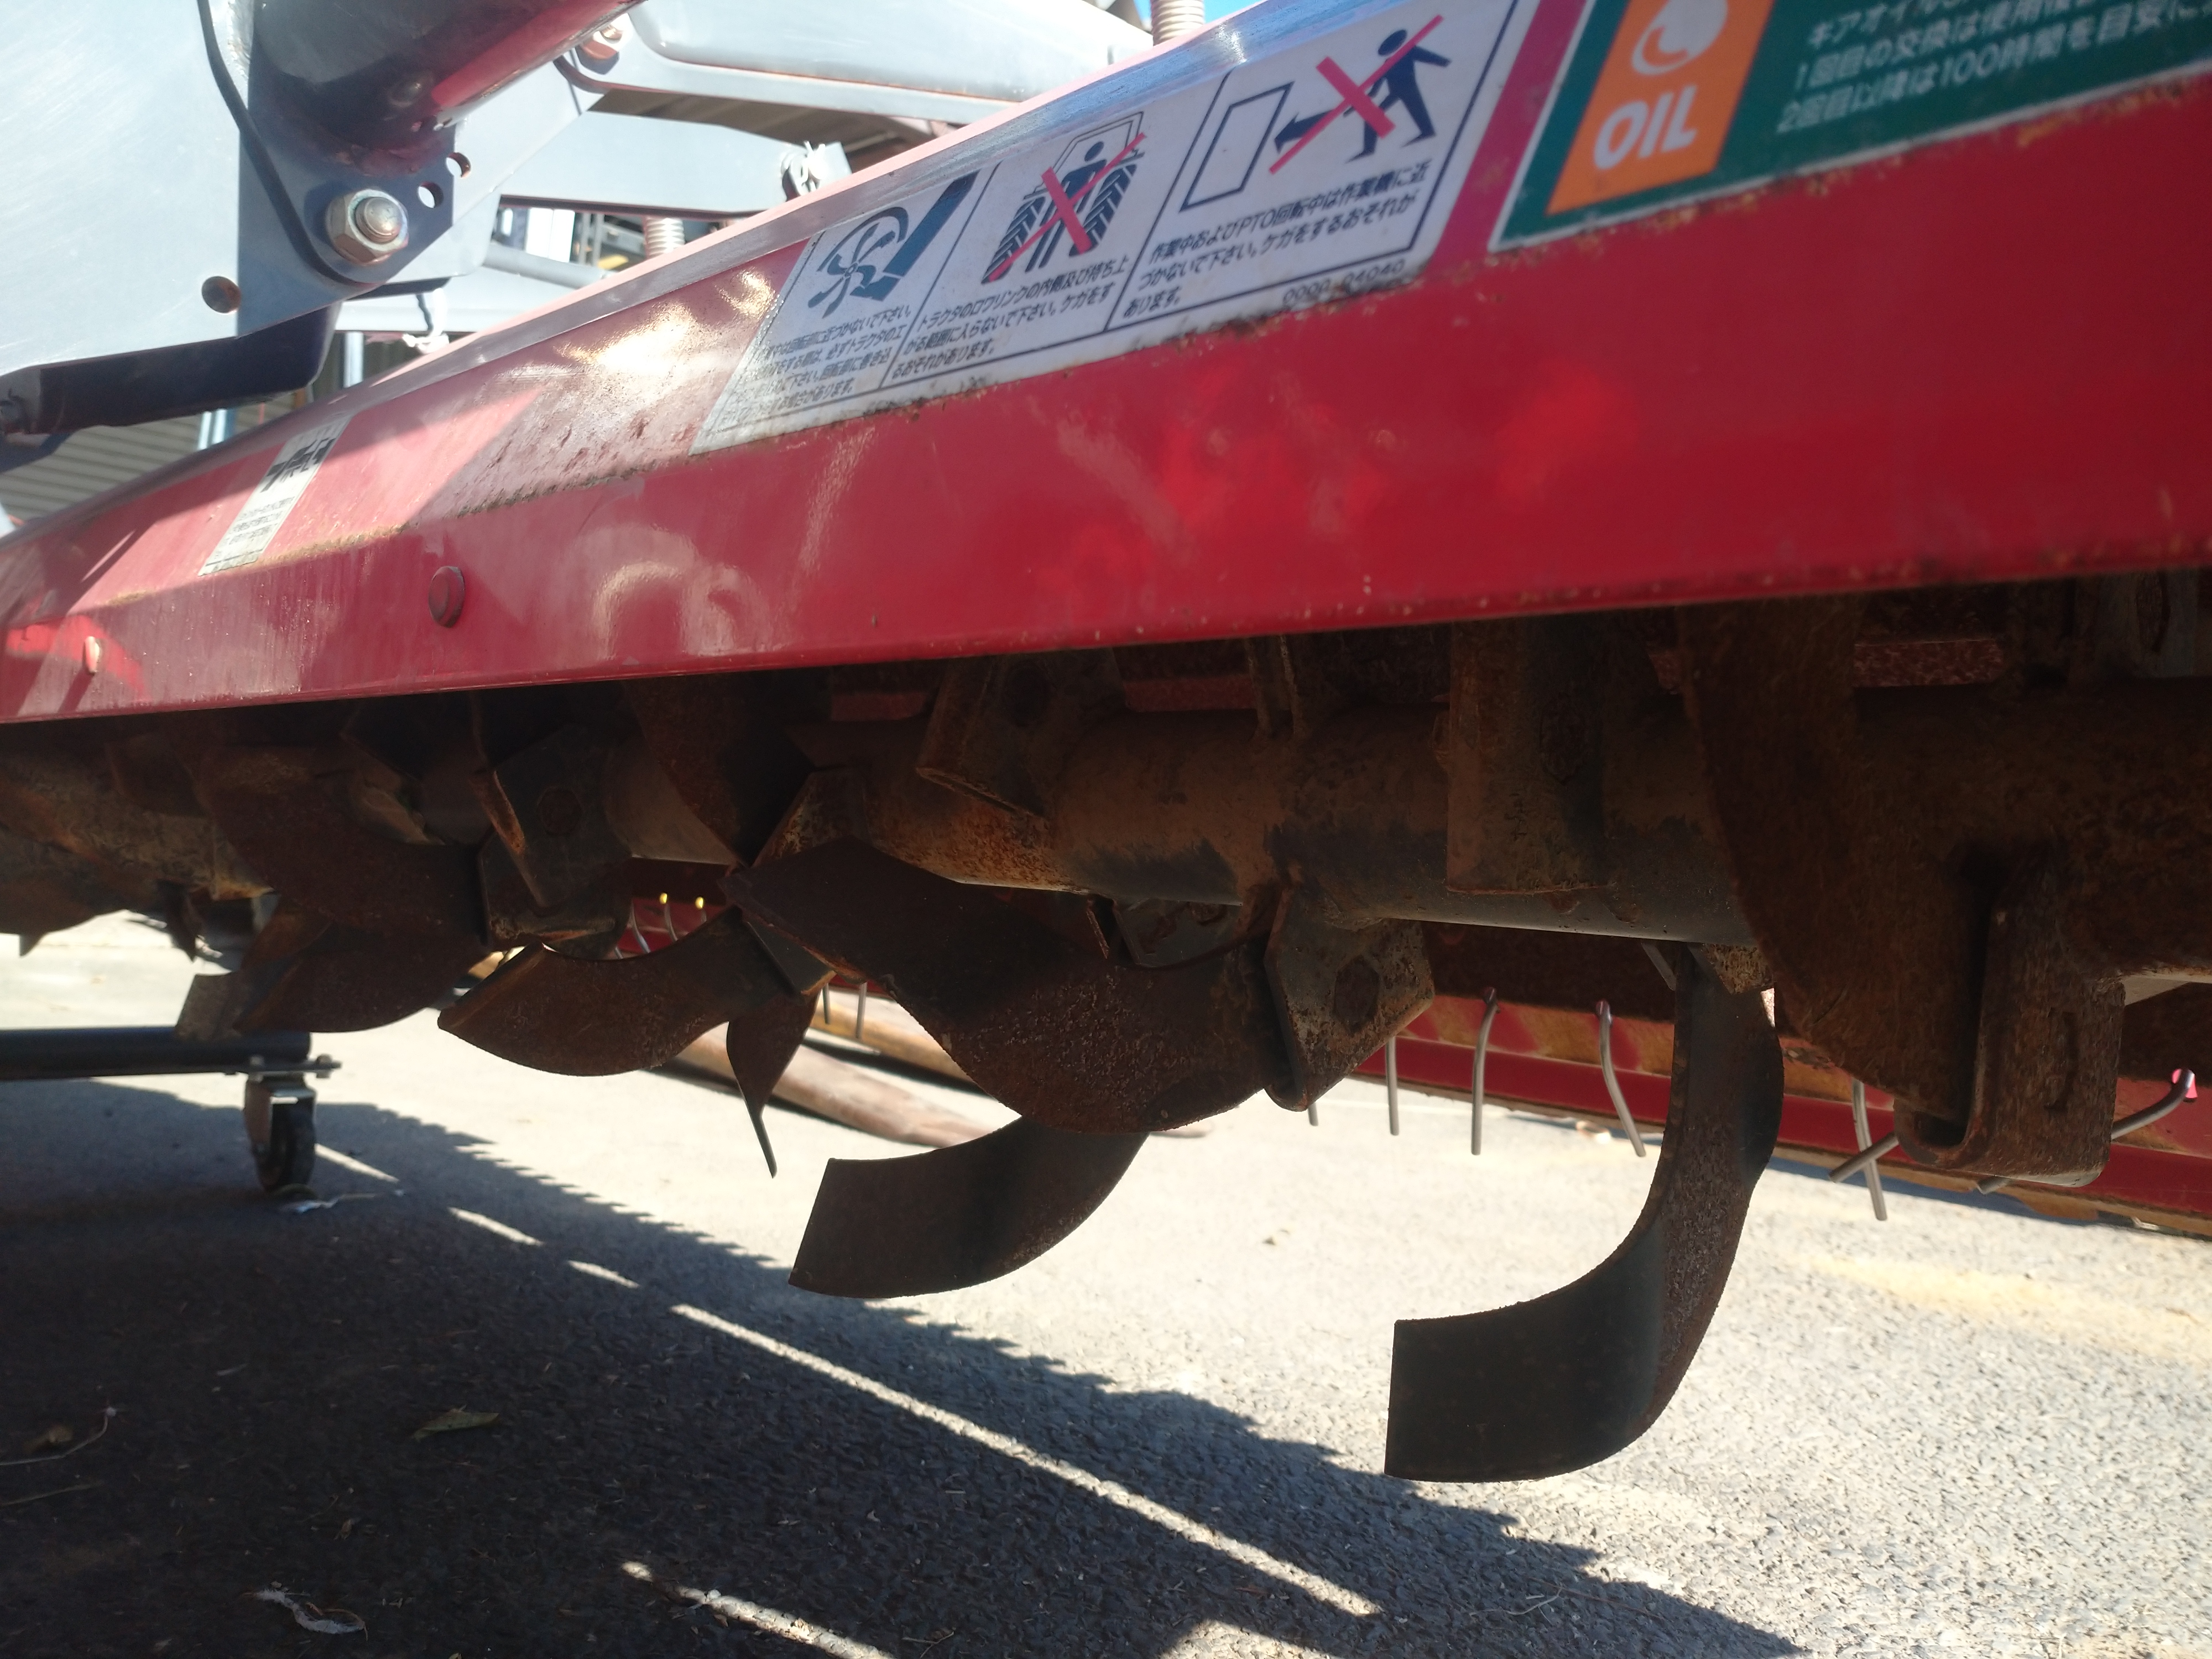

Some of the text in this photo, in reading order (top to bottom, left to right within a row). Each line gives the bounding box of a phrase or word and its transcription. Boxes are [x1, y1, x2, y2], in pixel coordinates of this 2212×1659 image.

[1594, 84, 1697, 170] OIL
[1123, 286, 1181, 317] あります。
[891, 336, 995, 379] るおそれがあります。
